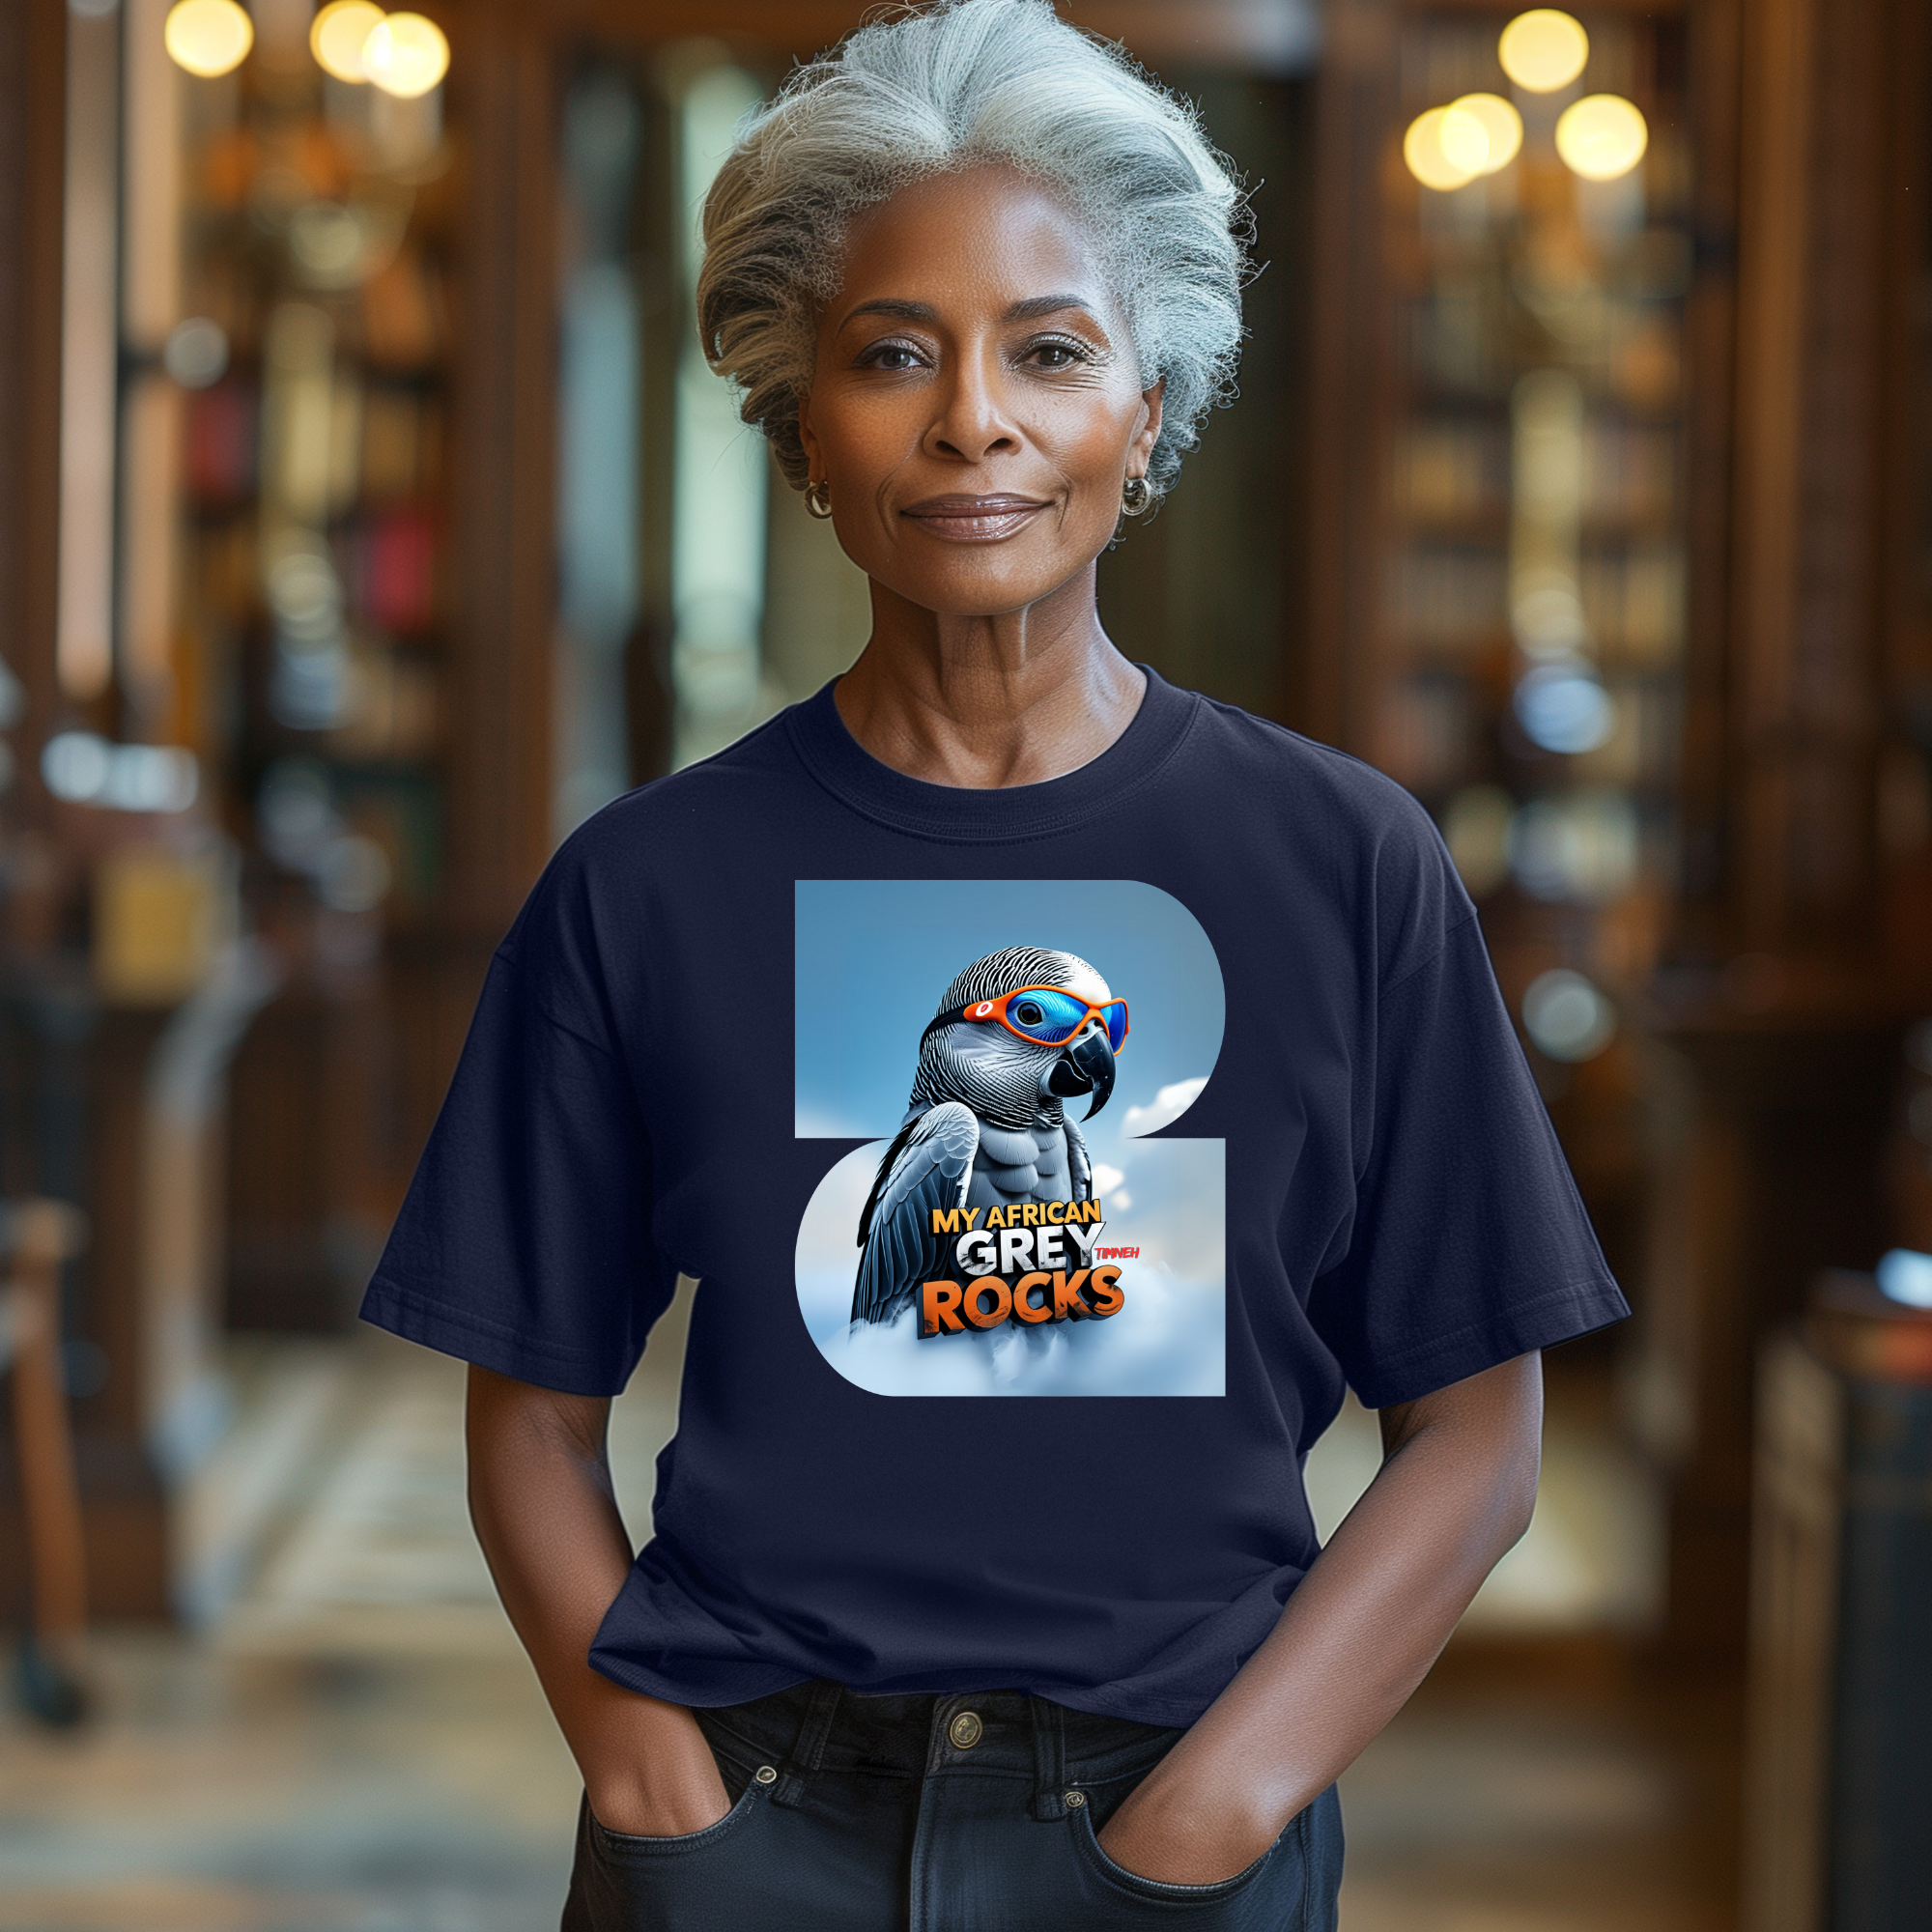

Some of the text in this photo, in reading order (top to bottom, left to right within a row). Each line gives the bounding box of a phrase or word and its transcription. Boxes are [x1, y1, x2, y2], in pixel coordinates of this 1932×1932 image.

[932, 1199, 1102, 1235] MY AFRICAN
[955, 1221, 1107, 1276] GREY
[1094, 1246, 1140, 1261] TIMNEH
[921, 1264, 1125, 1336] ROCKS
